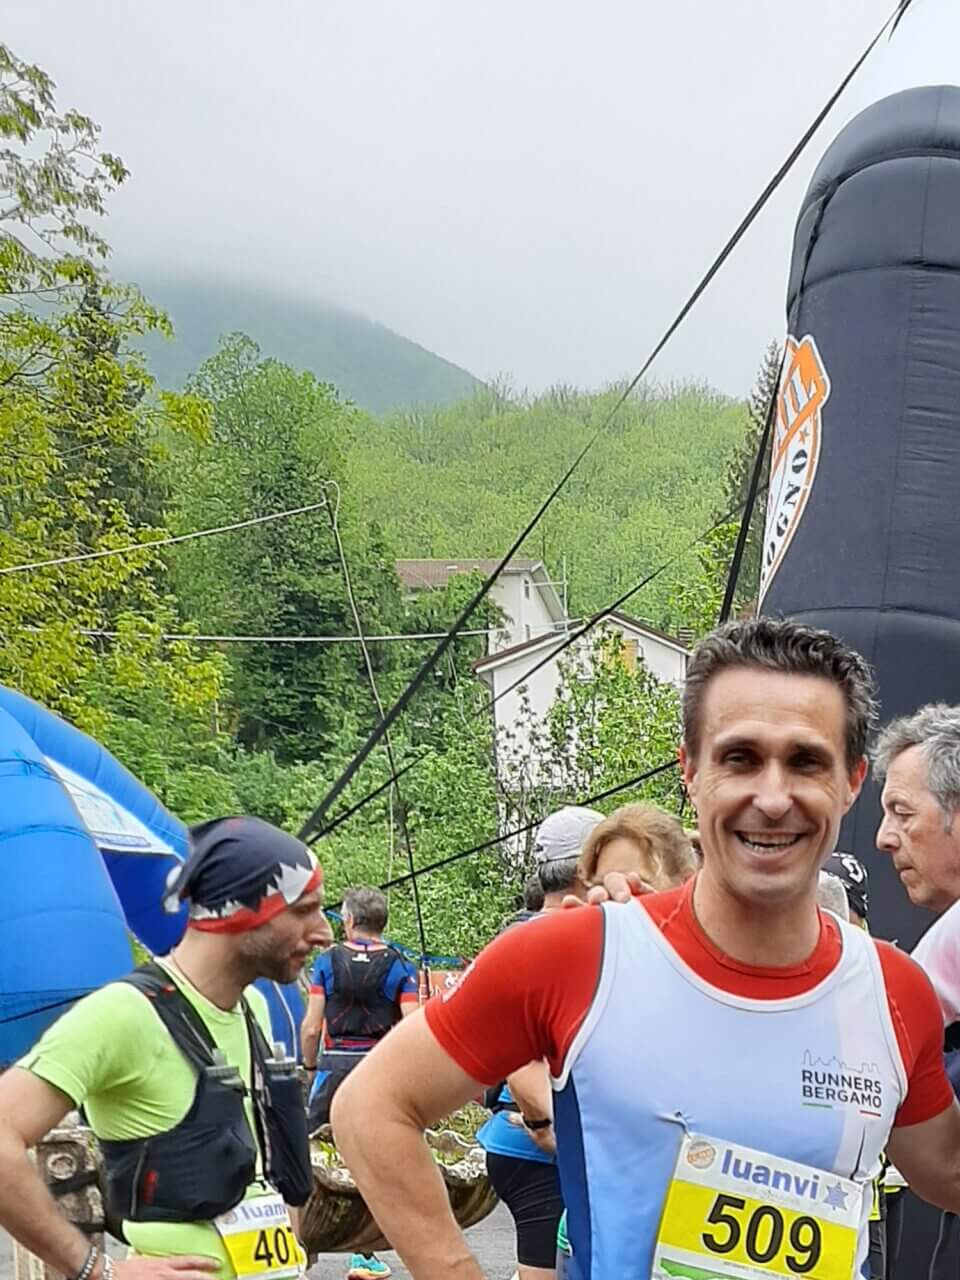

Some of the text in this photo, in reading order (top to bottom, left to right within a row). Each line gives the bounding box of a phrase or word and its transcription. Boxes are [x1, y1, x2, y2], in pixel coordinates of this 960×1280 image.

[801, 1069, 882, 1095] RUNNERS
[802, 1085, 882, 1109] BERGAMO
[721, 1149, 820, 1200] luanvi
[702, 1193, 822, 1274] 509
